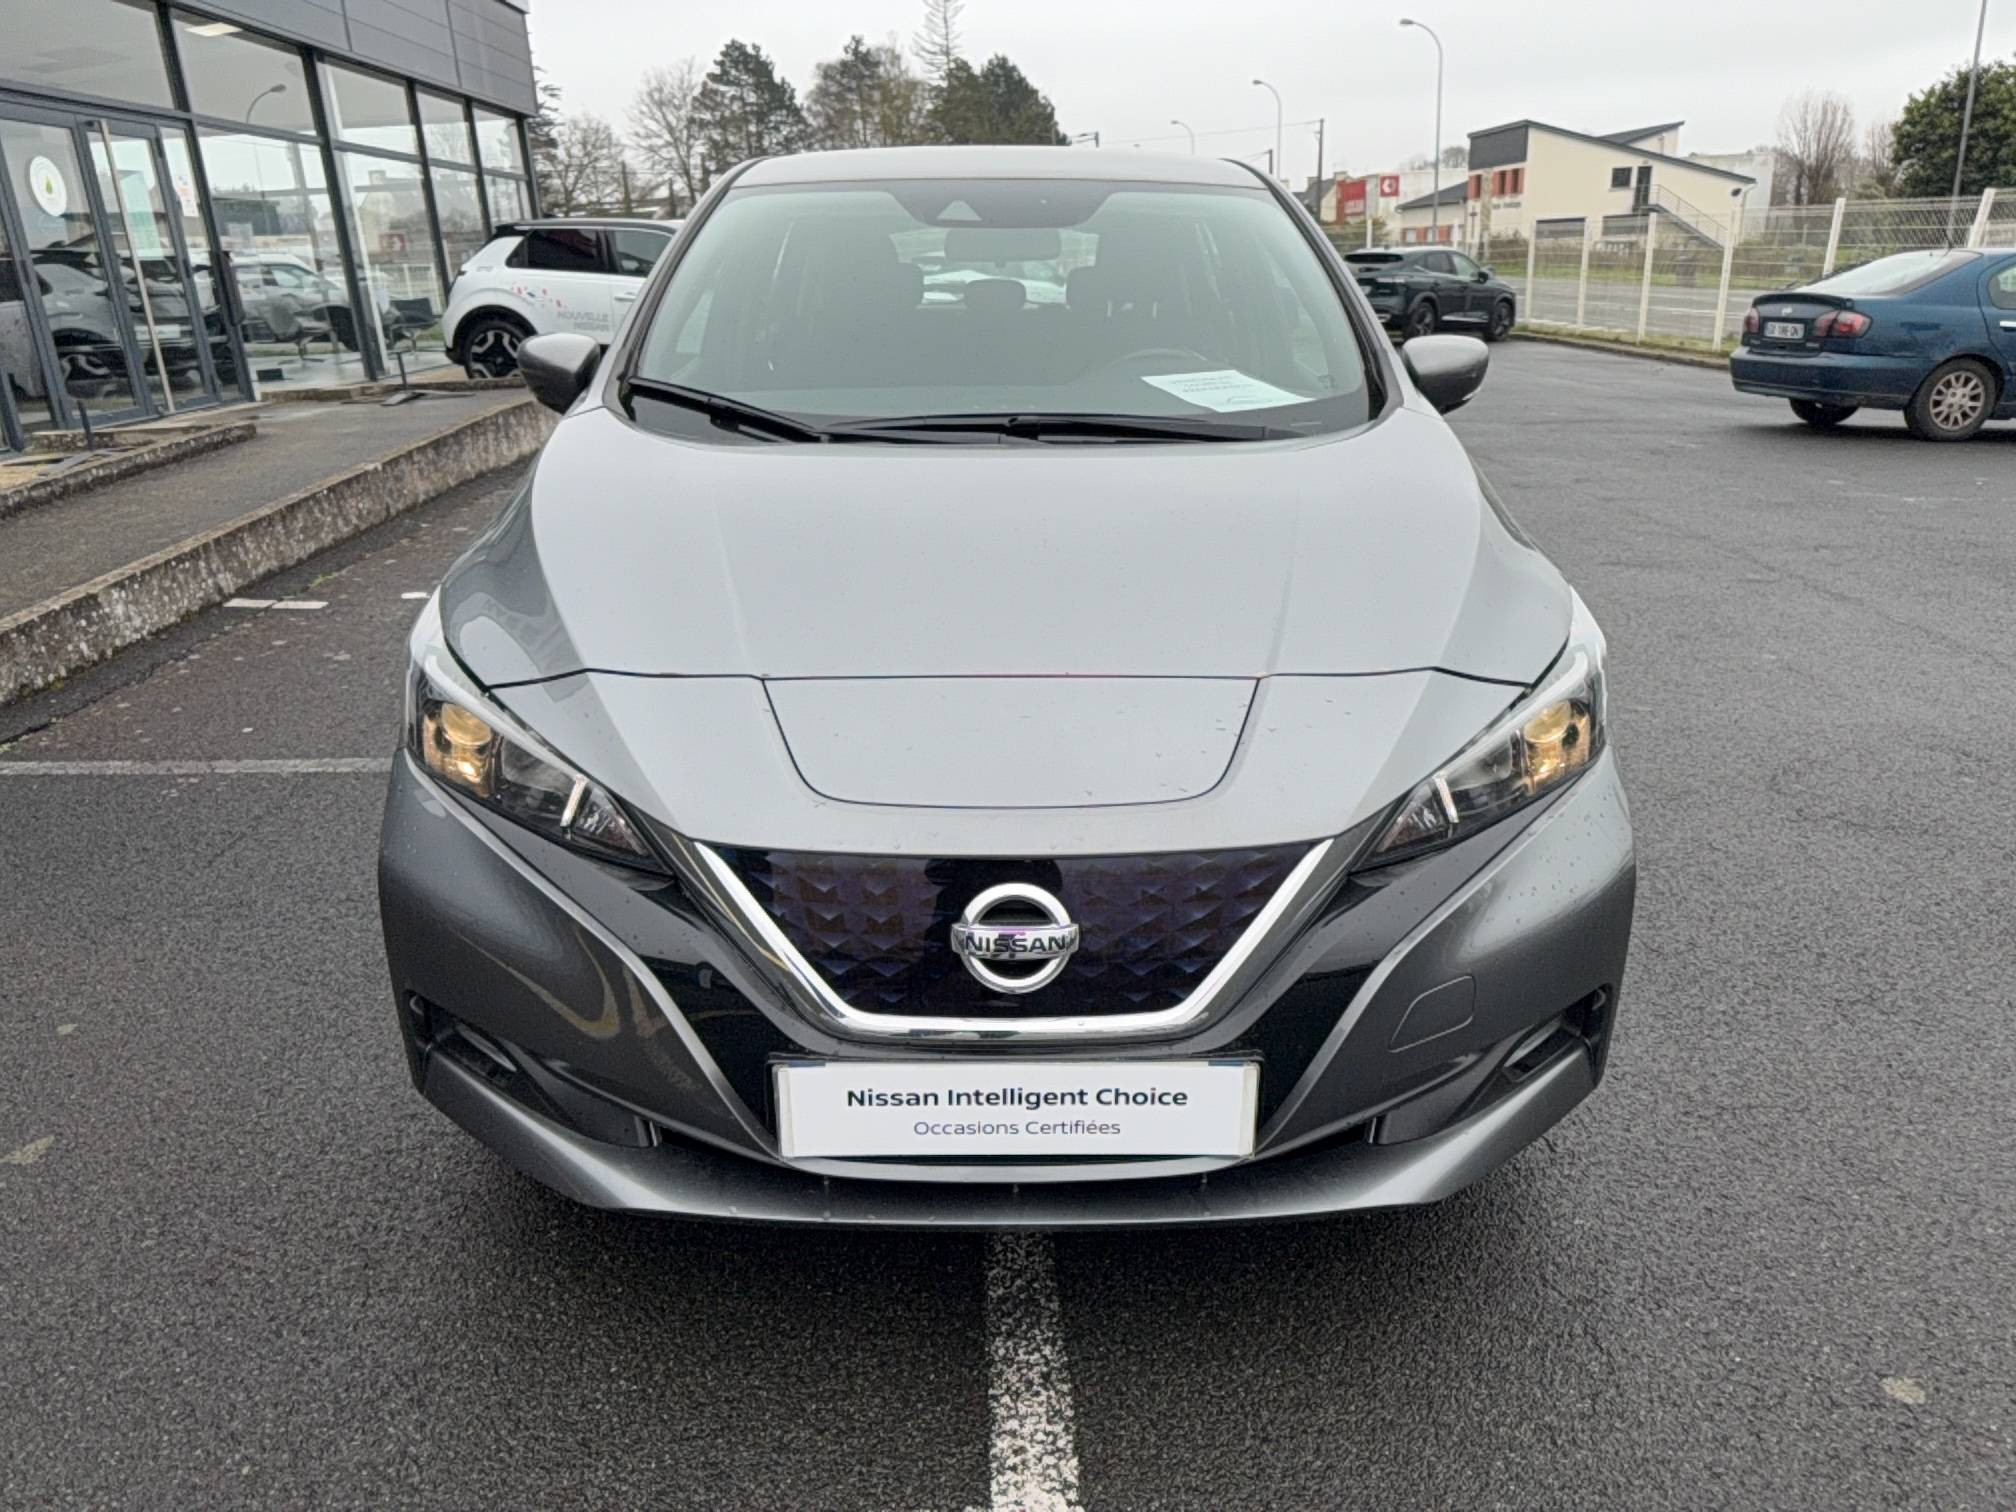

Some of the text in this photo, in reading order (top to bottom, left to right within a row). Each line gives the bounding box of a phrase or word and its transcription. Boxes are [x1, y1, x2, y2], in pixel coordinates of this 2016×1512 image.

[558, 311, 608, 322] NOUVELLE
[965, 932, 1066, 953] NISSAN
[847, 1087, 1188, 1111] Nissan Intelligent Choice
[914, 1119, 1121, 1136] Occasions Certifiées
